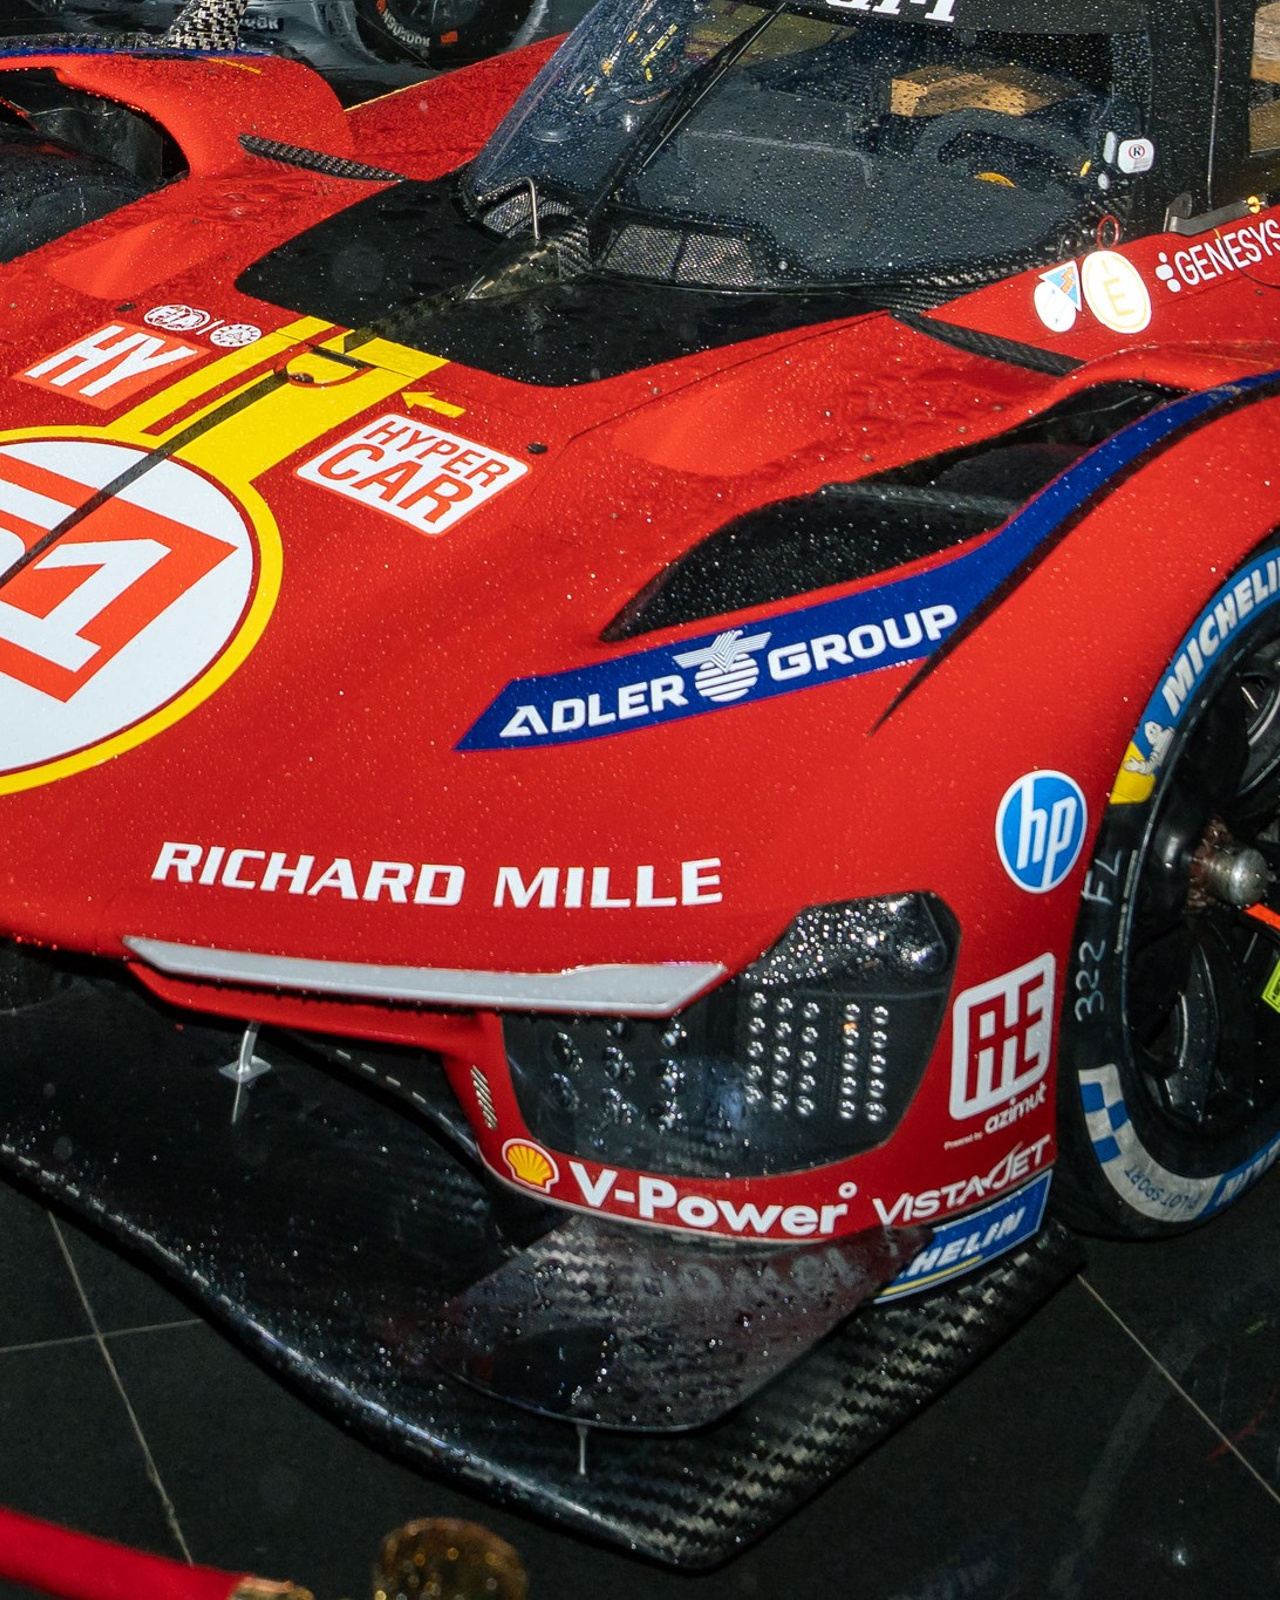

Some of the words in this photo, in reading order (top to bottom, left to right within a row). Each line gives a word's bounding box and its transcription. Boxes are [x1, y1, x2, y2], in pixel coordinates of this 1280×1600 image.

[1174, 219, 1280, 286] GENESYS
[24, 324, 200, 398] HY
[315, 443, 470, 523] CAR
[361, 419, 511, 489] HYPER
[500, 674, 689, 737] ADLER
[767, 604, 960, 682] GROUP
[1161, 555, 1280, 717] MICHELI
[1016, 778, 1078, 890] hp
[151, 841, 468, 907] RICHARD
[494, 857, 724, 908] MILLE
[984, 1081, 1047, 1135] azimut
[568, 1161, 858, 1237] V-Power
[902, 1206, 1027, 1278] HELIN
